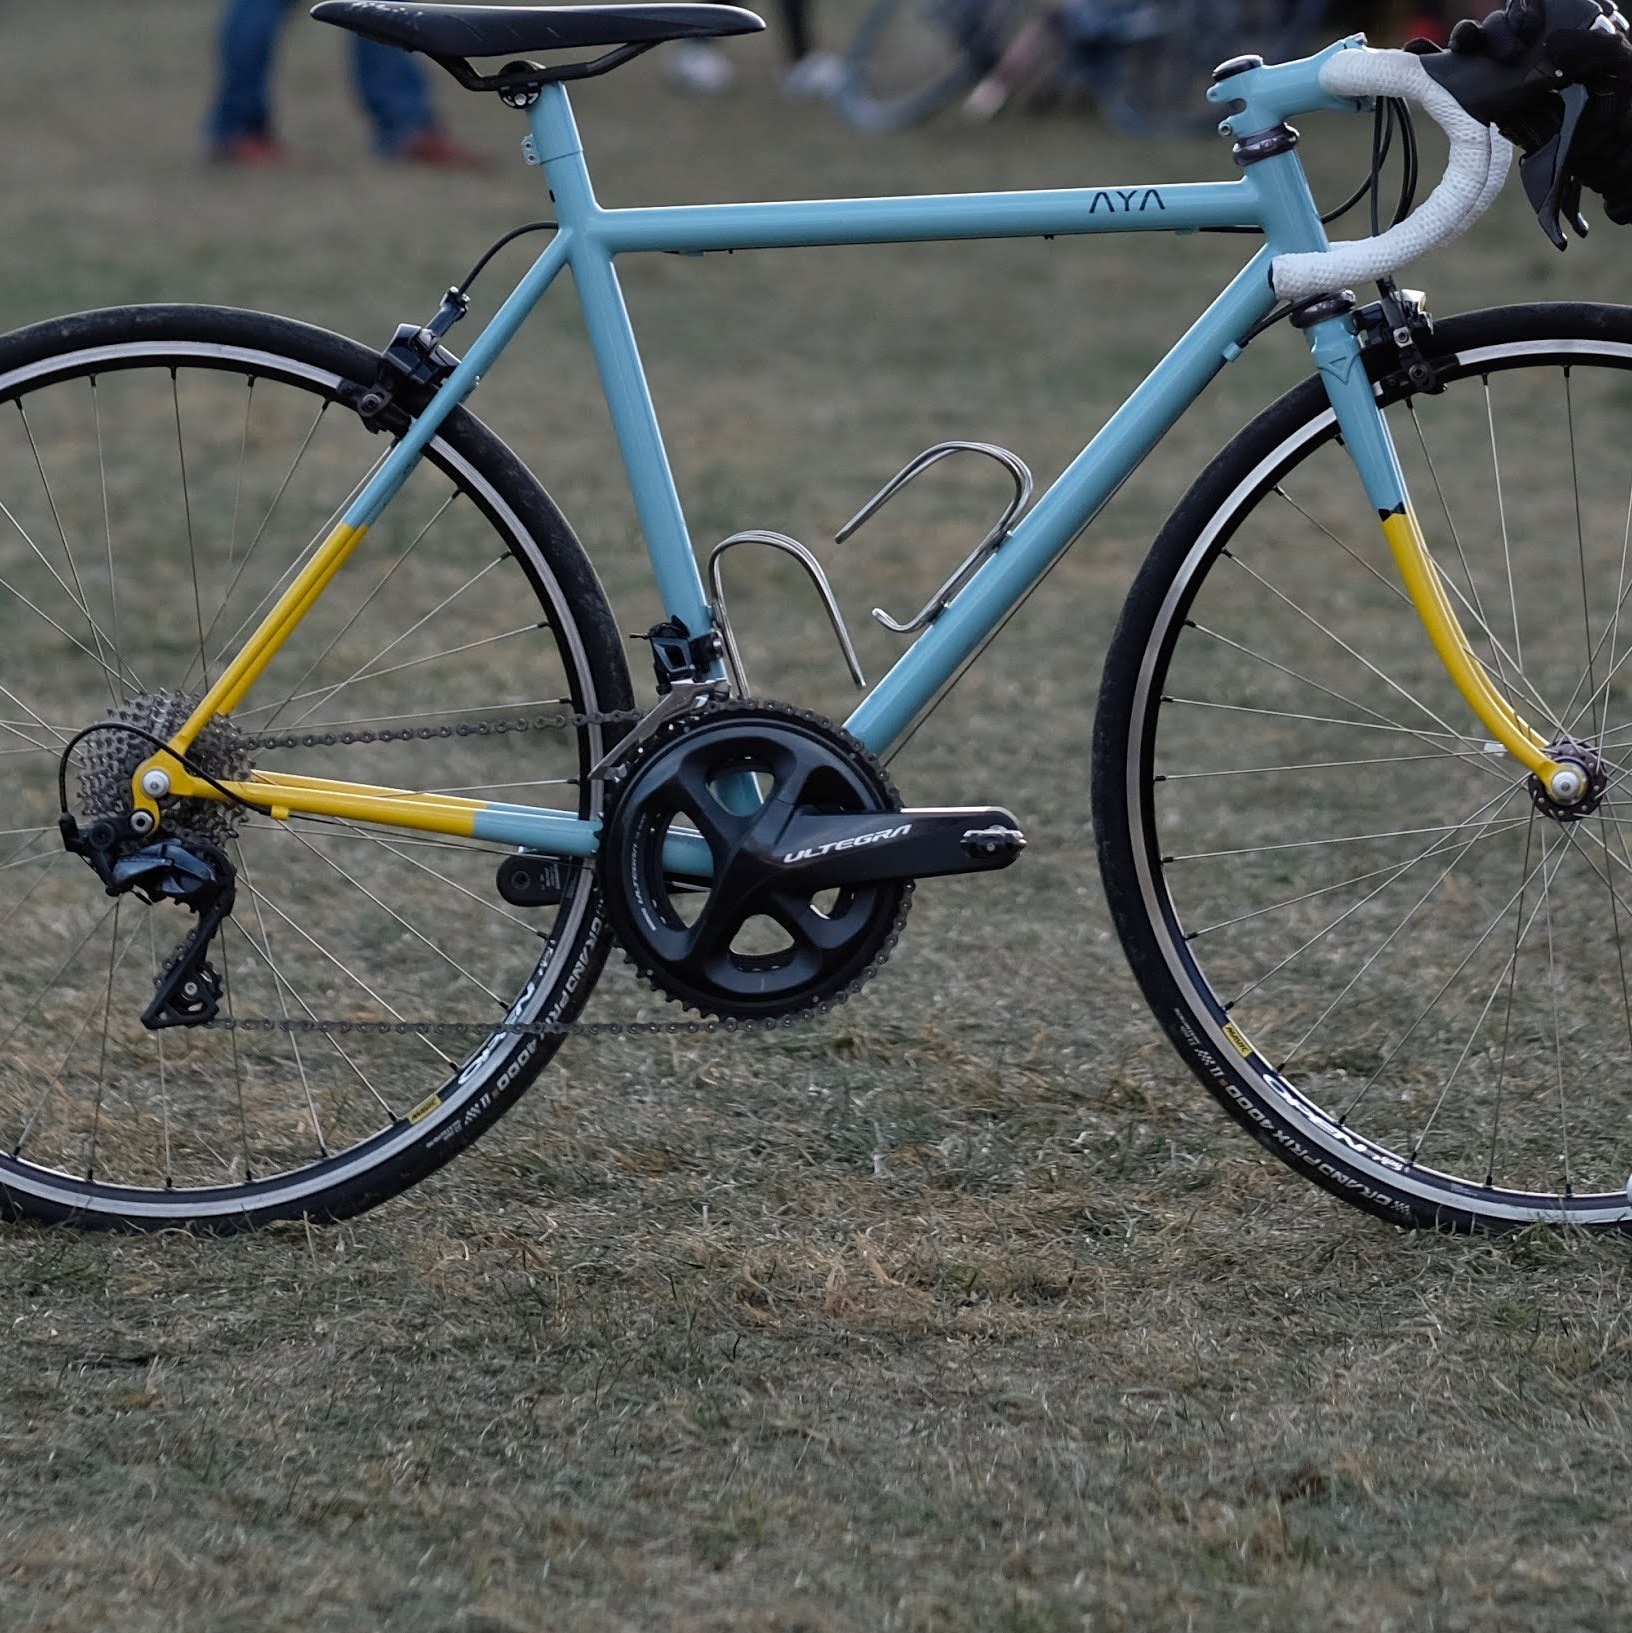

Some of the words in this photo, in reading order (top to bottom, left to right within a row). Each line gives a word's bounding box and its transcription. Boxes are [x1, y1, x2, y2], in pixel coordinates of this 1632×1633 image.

[1089, 189, 1166, 214] AYA
[783, 824, 912, 863] ULTEGRA
[496, 1039, 537, 1091] 4000
[1225, 1085, 1275, 1129] 4000
[1262, 1074, 1367, 1152] OPEN
[1272, 1129, 1322, 1166] PRIX
[1318, 1163, 1393, 1206] GRAND
